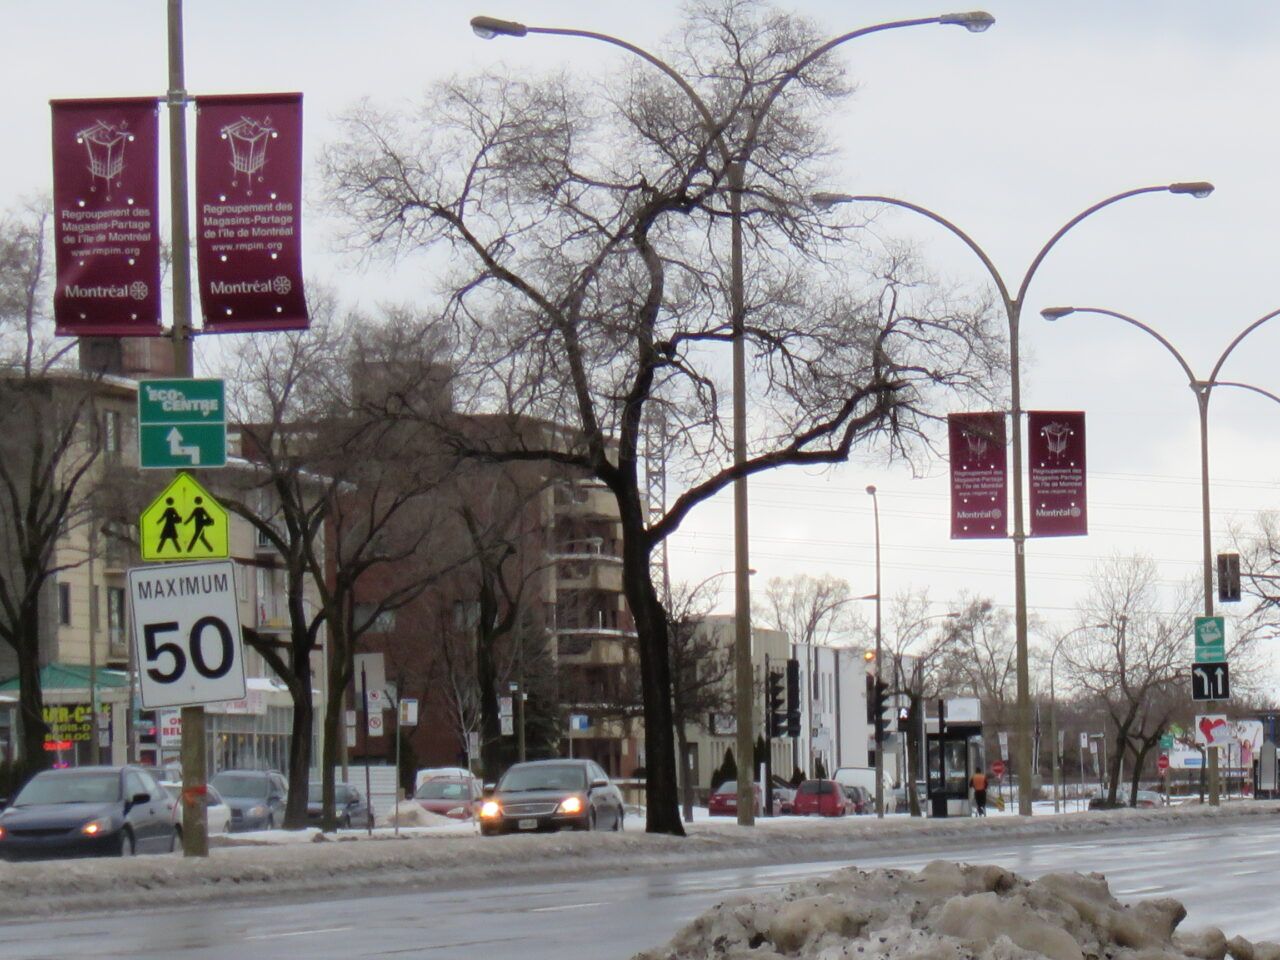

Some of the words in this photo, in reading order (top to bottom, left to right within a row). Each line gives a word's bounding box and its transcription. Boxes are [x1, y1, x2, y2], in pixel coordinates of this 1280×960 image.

[62, 209, 130, 221] Regroupement
[132, 208, 151, 217] des
[204, 204, 273, 216] Regroupement
[275, 202, 293, 212] des
[62, 220, 151, 233] Magasins-Partage
[204, 215, 294, 227] Magasins-Partage
[63, 234, 76, 244] de
[96, 233, 106, 242] de
[108, 232, 151, 242] Montréal
[204, 229, 216, 239] de
[237, 228, 249, 238] de
[252, 227, 293, 237] Montréal
[64, 284, 129, 298] Montréal
[210, 279, 272, 295] Montréal
[162, 399, 218, 417] CENTRE
[957, 509, 992, 519] Montréal
[1036, 507, 1071, 517] Montréal
[137, 573, 229, 599] MAXIMUM
[143, 616, 235, 684] 50
